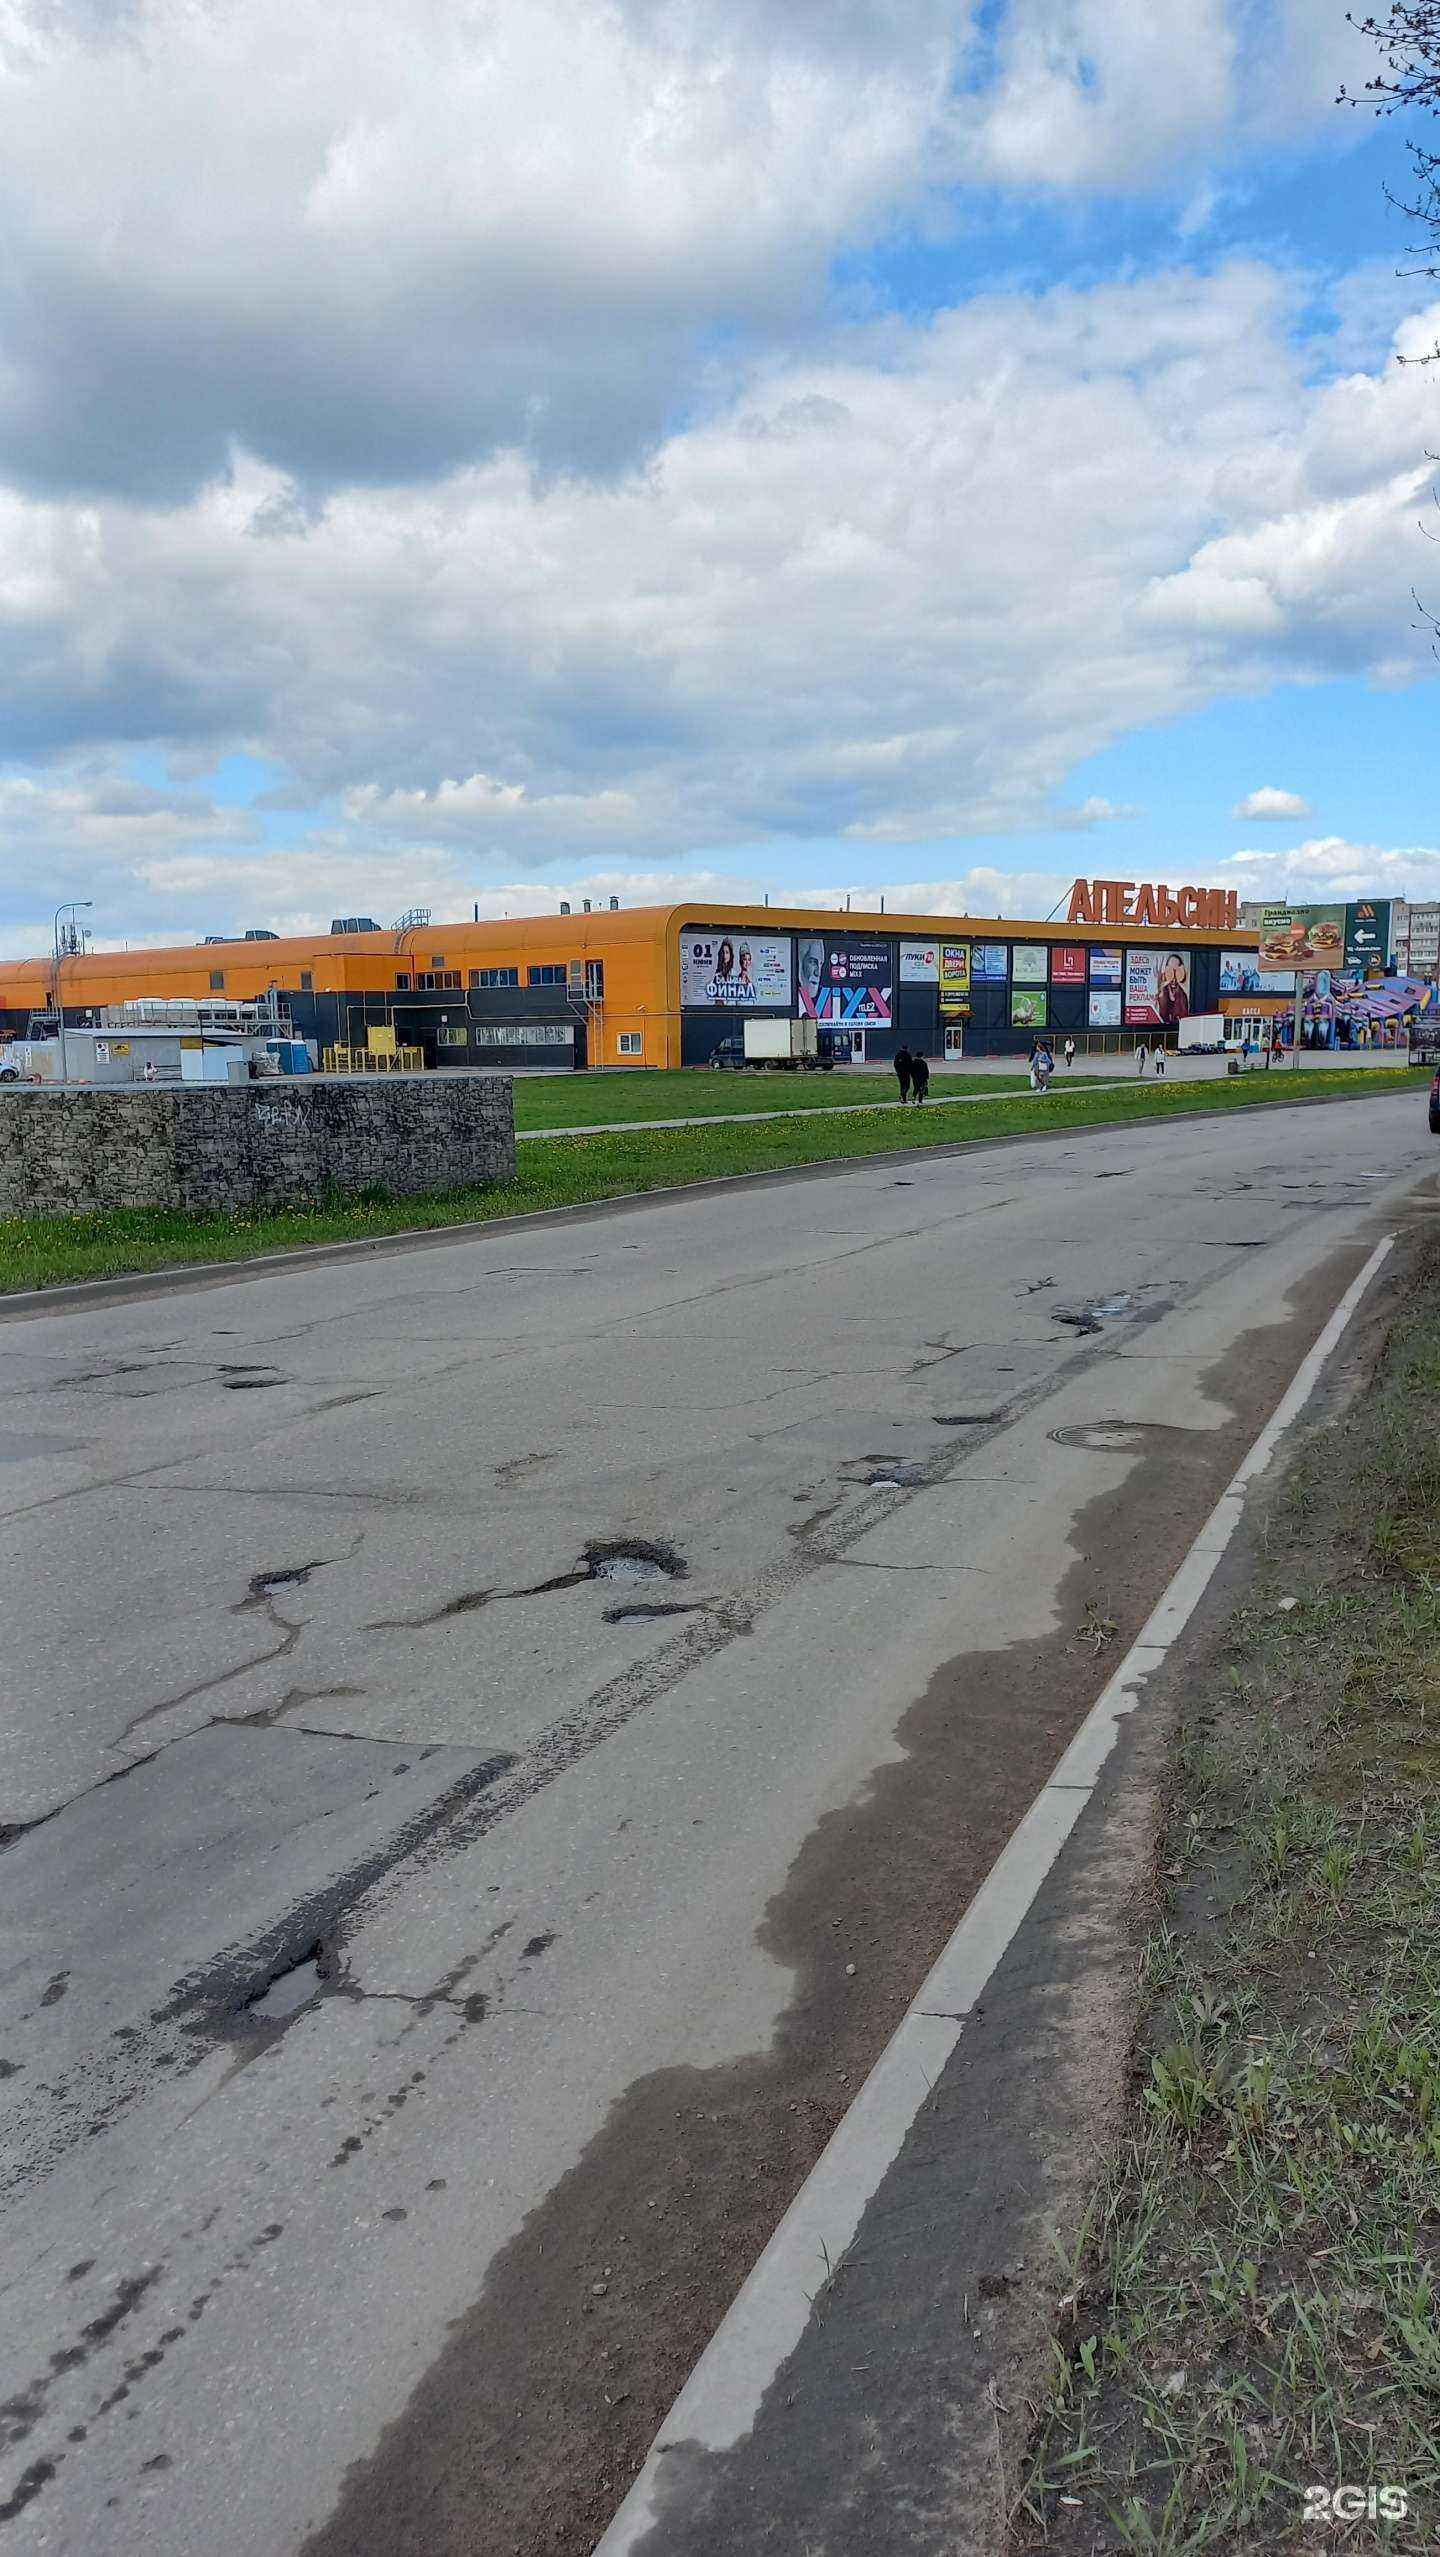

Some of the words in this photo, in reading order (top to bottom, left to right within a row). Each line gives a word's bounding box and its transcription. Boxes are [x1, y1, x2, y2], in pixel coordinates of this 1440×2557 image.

[1067, 879, 1238, 929] АПЕЛЬСИН
[693, 944, 712, 957] 01
[945, 948, 965, 958] ОКНА
[1130, 955, 1150, 964] ЗДЕСЬ
[849, 962, 878, 970] ПОДПИСКА
[1130, 967, 1152, 975] МОЖЕТ
[707, 983, 755, 997] ФИНАЛ
